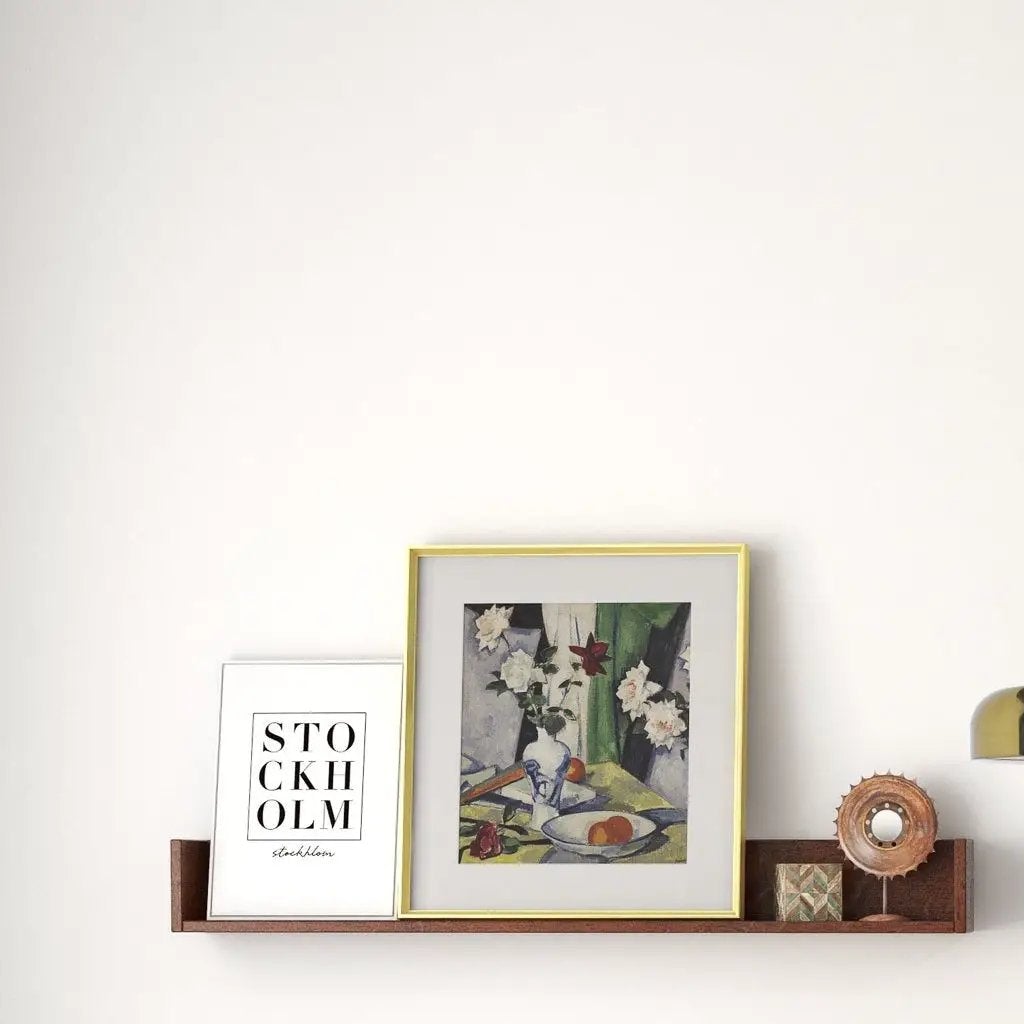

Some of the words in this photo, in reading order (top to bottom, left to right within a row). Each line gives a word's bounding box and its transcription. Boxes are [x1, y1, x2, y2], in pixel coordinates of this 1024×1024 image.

[262, 721, 356, 753] STO
[258, 760, 356, 791] CKH
[256, 799, 354, 830] OLM
